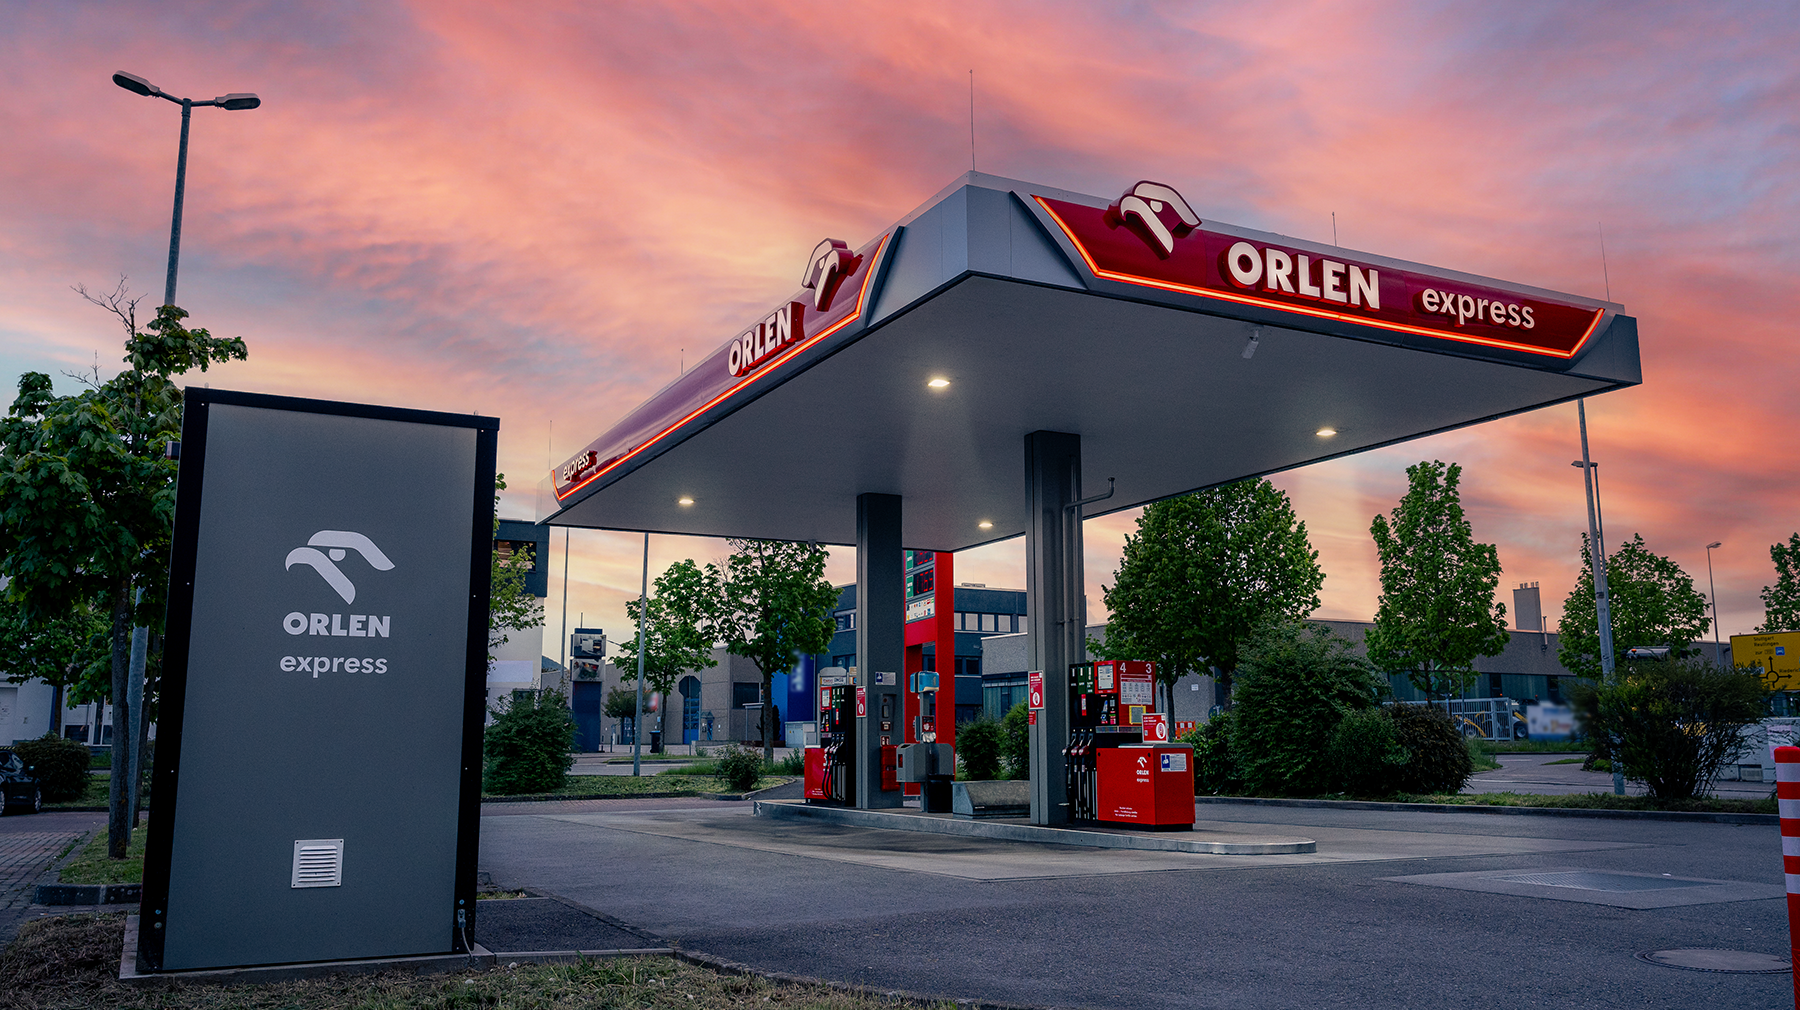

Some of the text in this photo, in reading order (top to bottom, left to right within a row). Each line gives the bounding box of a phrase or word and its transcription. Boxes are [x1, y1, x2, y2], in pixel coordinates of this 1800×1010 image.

[1228, 242, 1535, 329] ORLEN express
[728, 301, 793, 376] ORLEN
[563, 450, 590, 482] express
[283, 611, 391, 638] ORLEN
[280, 656, 388, 678] express
[1120, 662, 1126, 673] 4
[1145, 663, 1152, 674] 3
